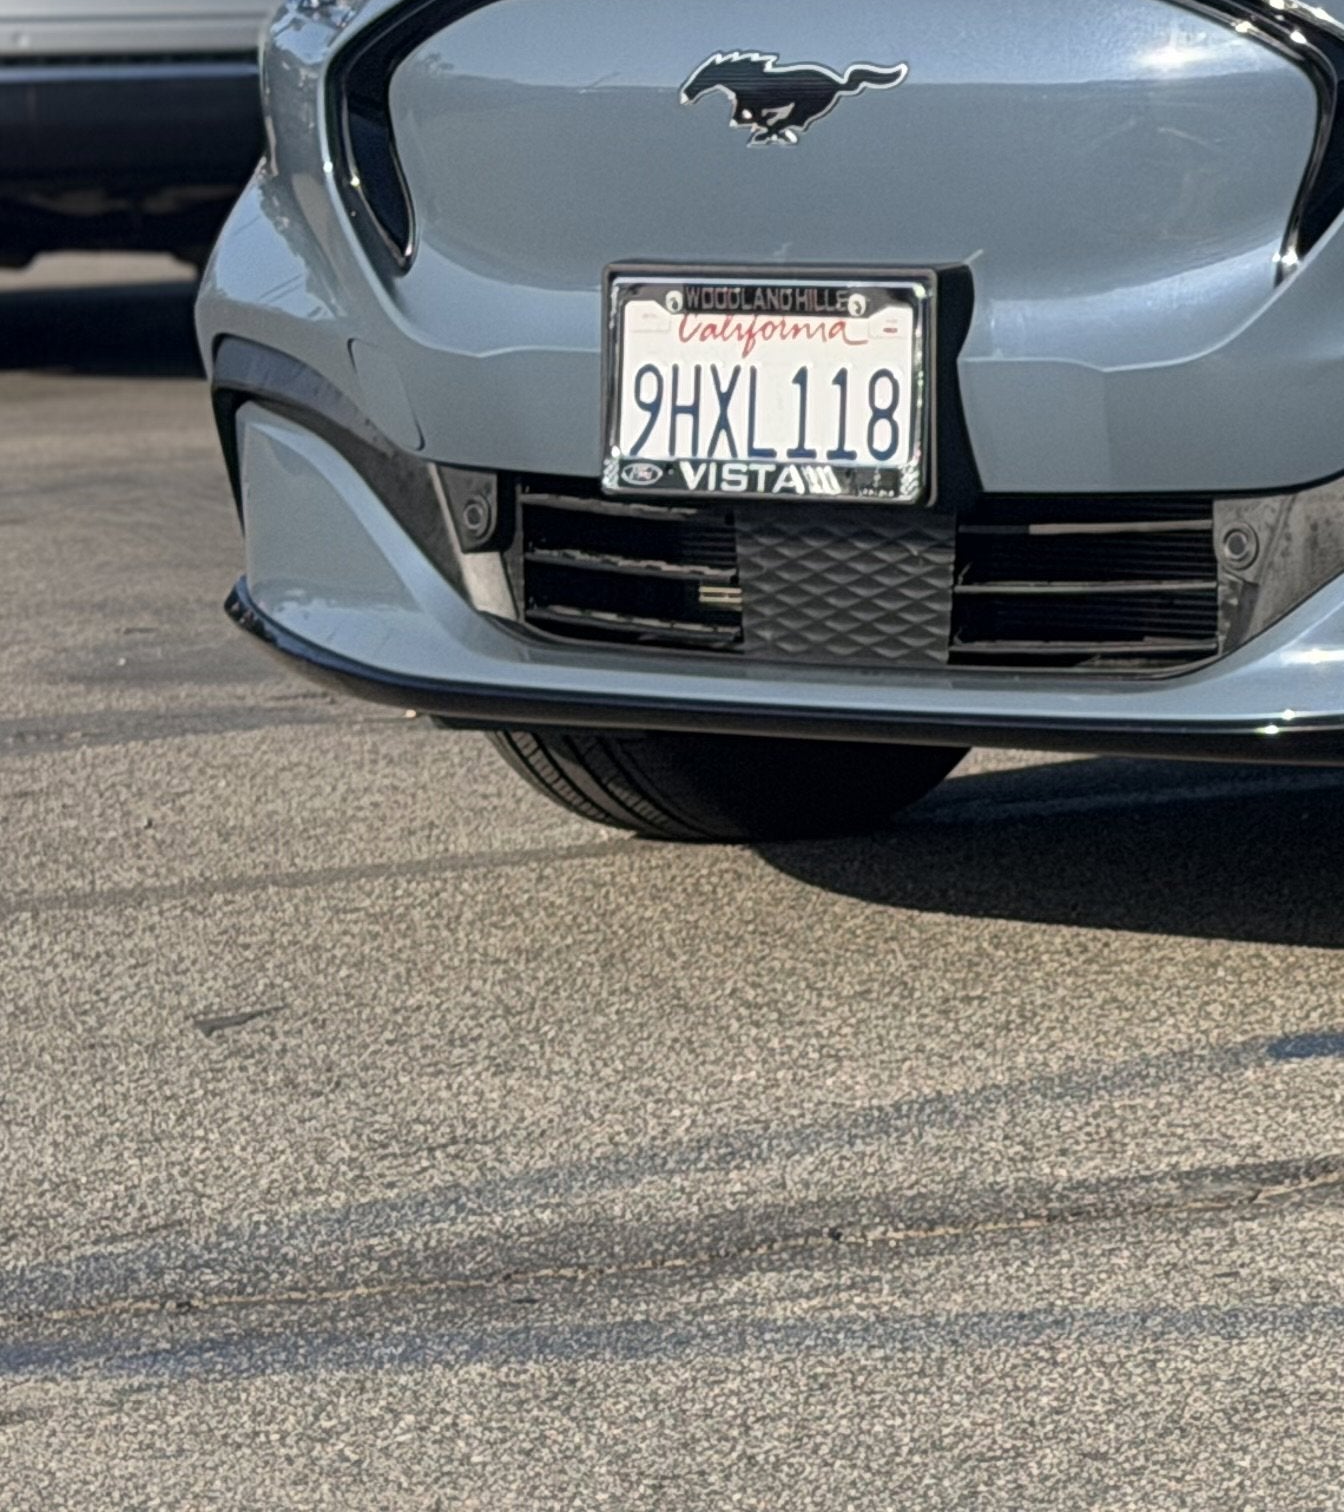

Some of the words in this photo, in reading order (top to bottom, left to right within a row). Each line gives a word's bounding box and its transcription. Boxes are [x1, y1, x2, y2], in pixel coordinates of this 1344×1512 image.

[686, 286, 793, 311] WOODLAND
[678, 312, 868, 358] California
[629, 363, 902, 460] 9HXL118
[679, 461, 805, 493] VISTA
